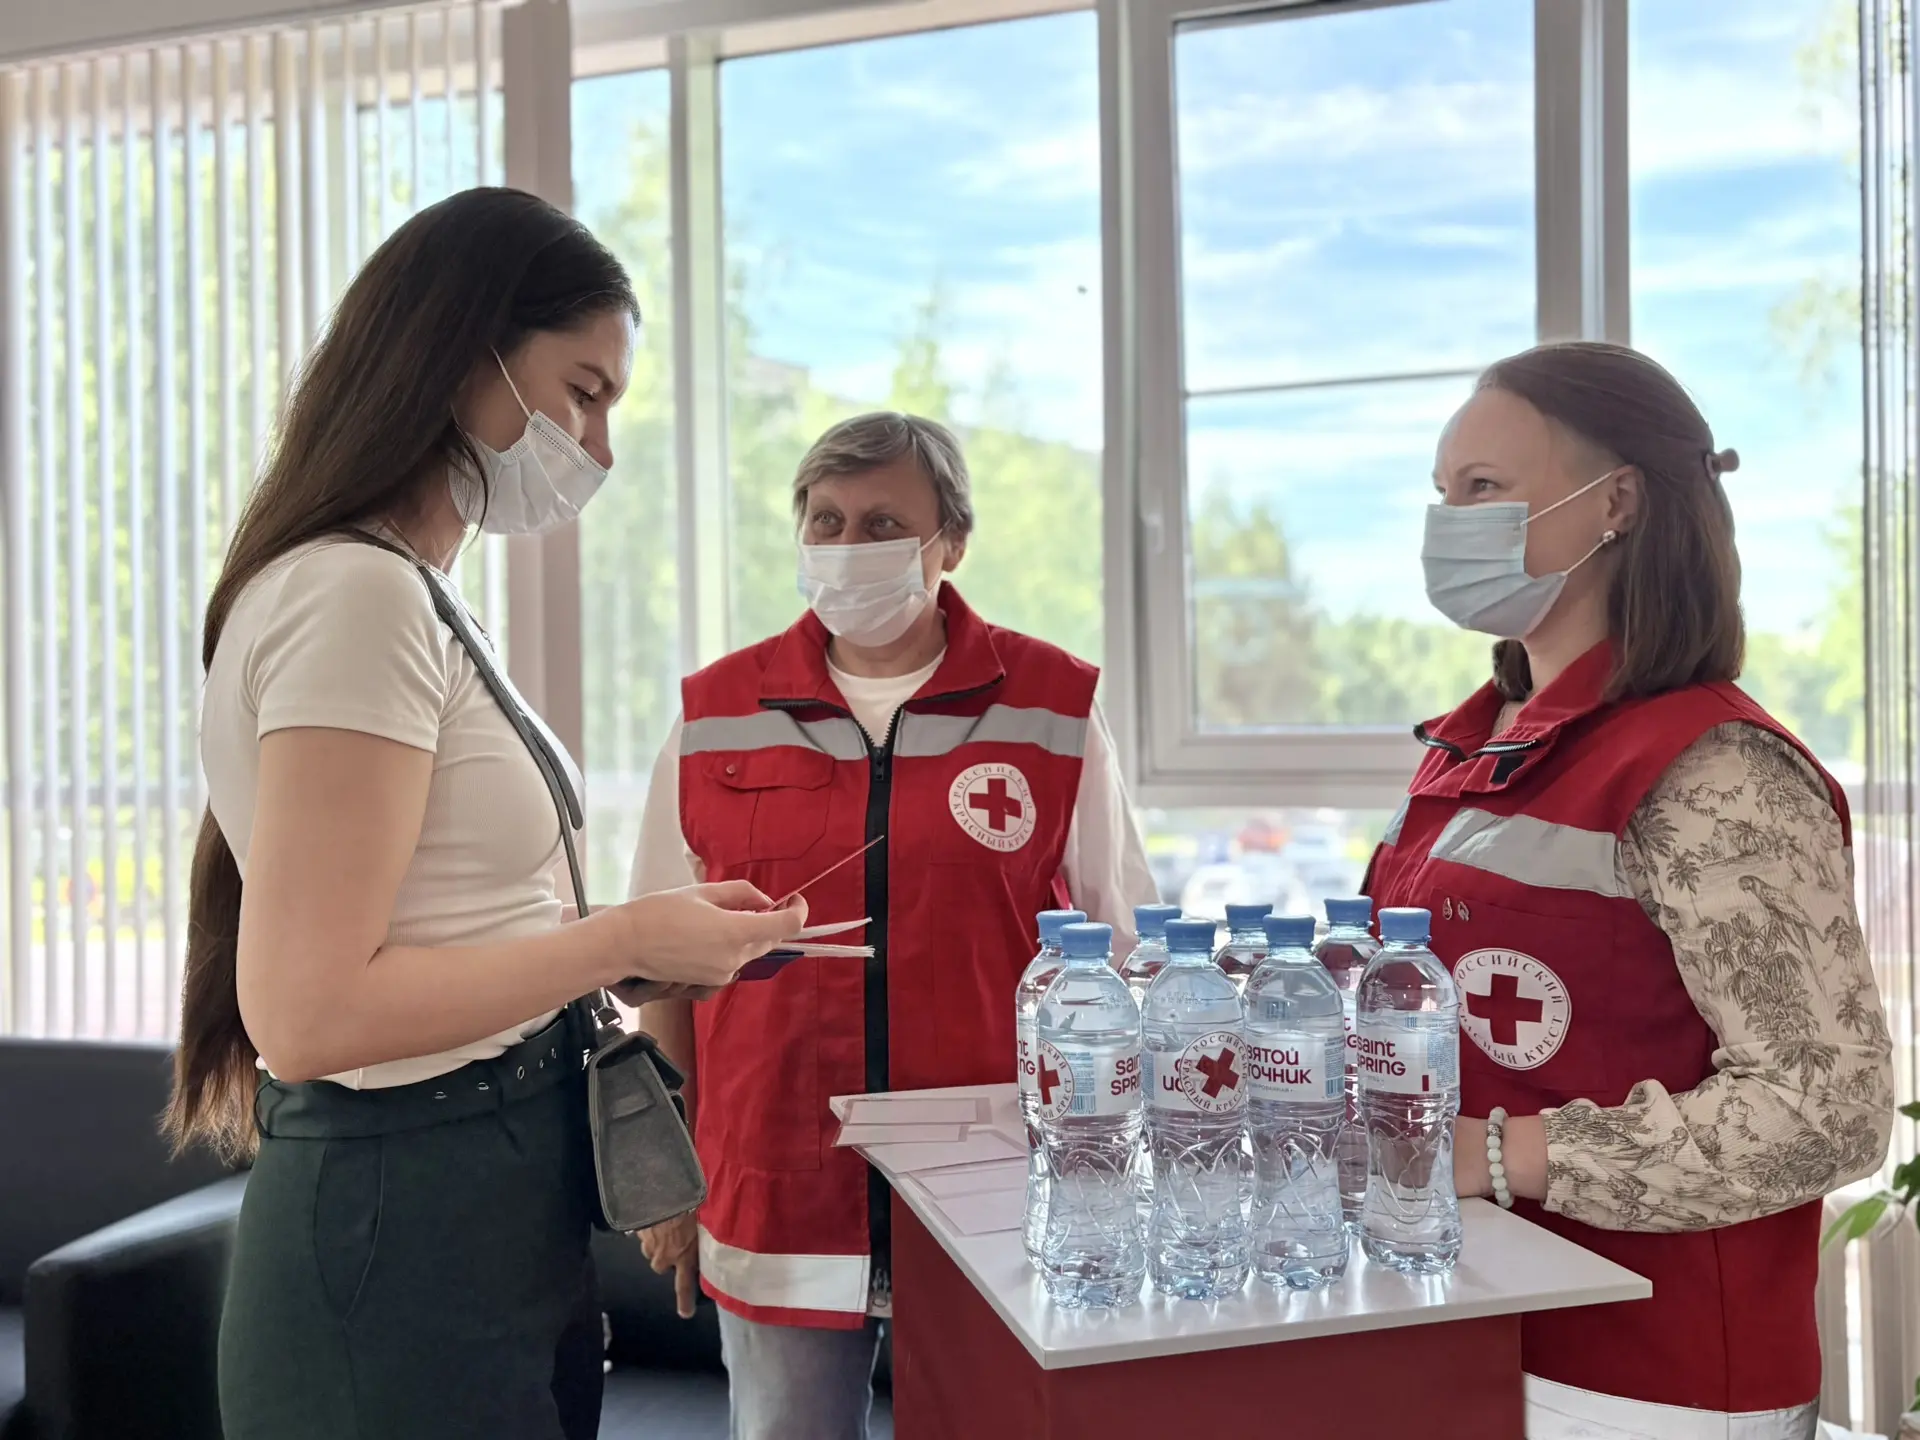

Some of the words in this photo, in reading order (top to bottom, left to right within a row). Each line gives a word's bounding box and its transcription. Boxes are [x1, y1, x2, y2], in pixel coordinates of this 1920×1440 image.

[953, 766, 1033, 809] РОССИЙСКИЙ
[953, 802, 1006, 849] КРАСНЫЙ
[1524, 1015, 1564, 1063] КРЕСТ
[1055, 1077, 1072, 1114] КРЕСТ
[1183, 1058, 1211, 1110] КРАСНЫЙ
